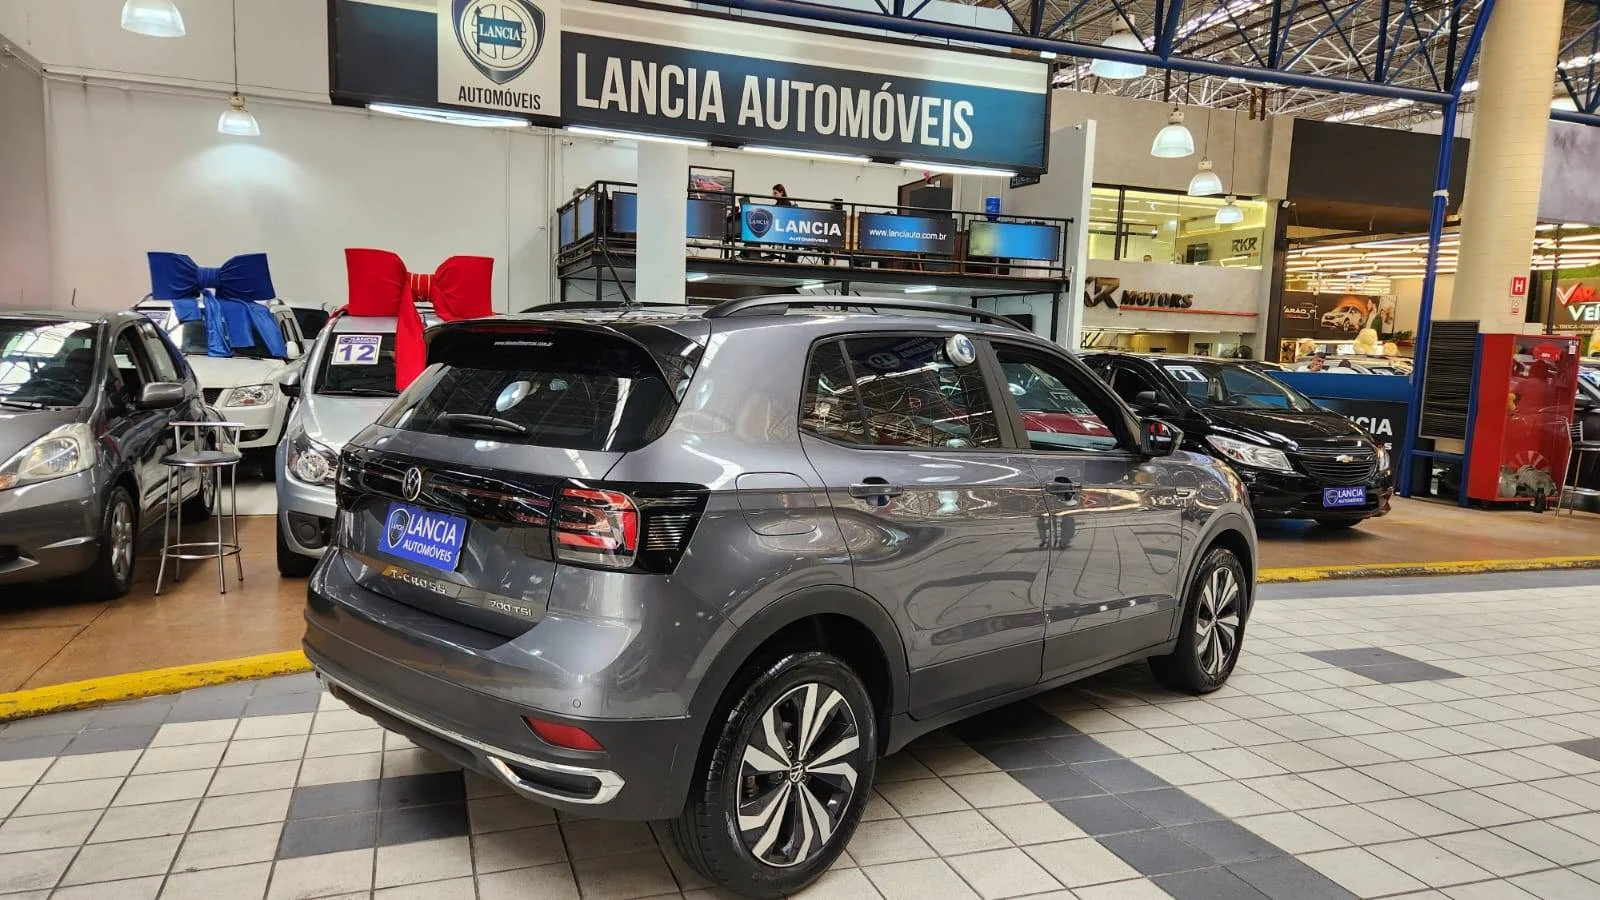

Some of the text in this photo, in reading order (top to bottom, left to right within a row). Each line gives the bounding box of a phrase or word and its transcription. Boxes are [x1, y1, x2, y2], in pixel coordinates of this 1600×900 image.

[479, 24, 521, 40] LANCIA
[458, 85, 541, 110] AUTOMÓVEIS
[576, 52, 974, 150] LANCIA AUTOMÓVEIS
[775, 219, 842, 236] LANCIA
[869, 228, 947, 241] www.lanciauto.com.br
[1514, 280, 1524, 293] H
[1120, 290, 1194, 308] MOTORS
[340, 345, 375, 361] 12
[1338, 488, 1363, 498] LANCIA
[408, 513, 457, 546] LANCIA
[402, 539, 452, 563] AUTOMÓVEIS
[391, 569, 447, 595] T-CROSS
[489, 600, 533, 617] 200 TSI
